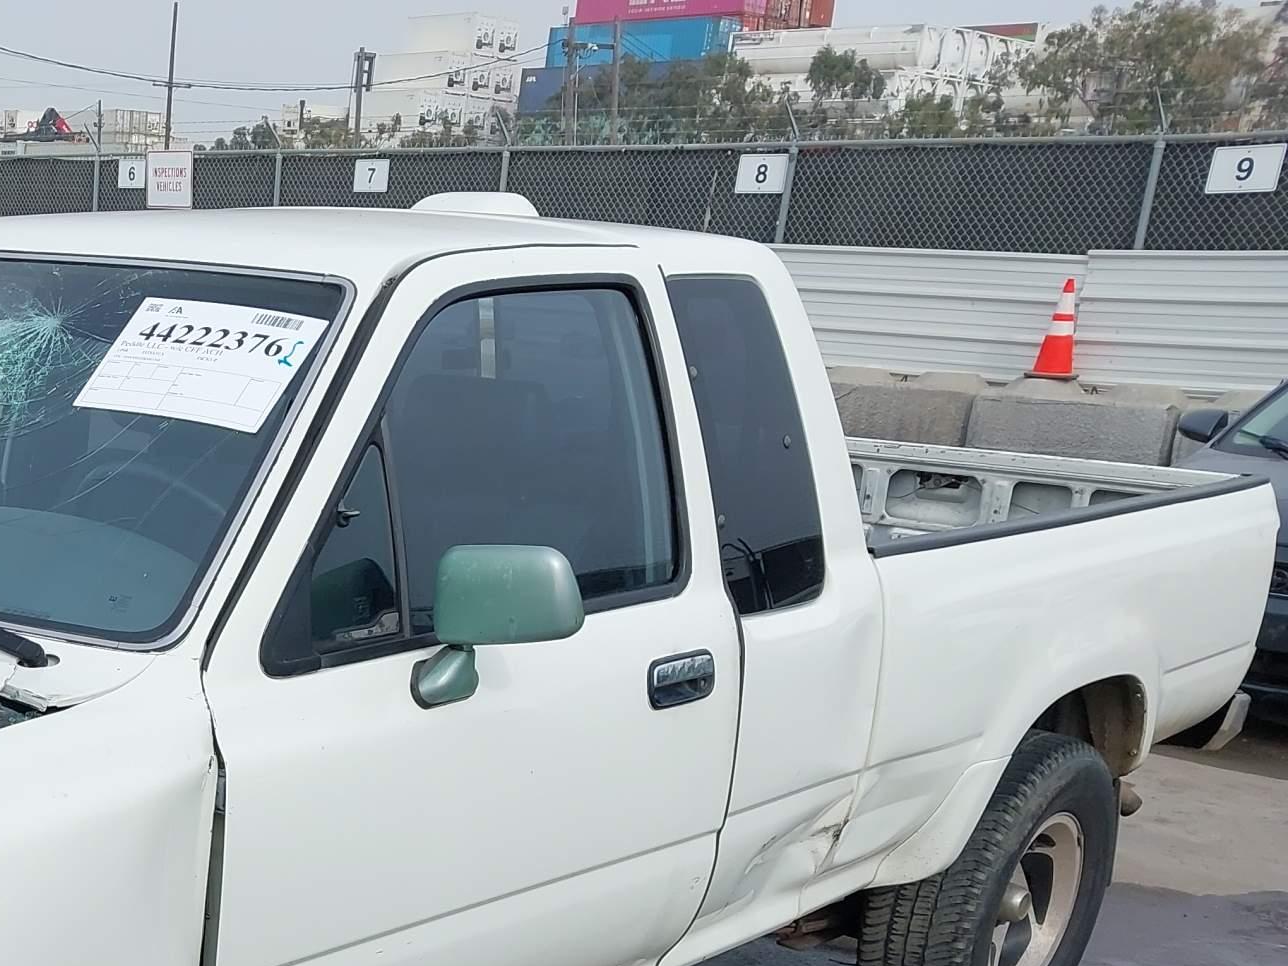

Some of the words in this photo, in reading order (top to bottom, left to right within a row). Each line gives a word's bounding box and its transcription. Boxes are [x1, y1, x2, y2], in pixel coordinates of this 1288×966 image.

[128, 166, 136, 181] 6
[152, 167, 188, 178] INSPECTIONS
[367, 167, 376, 184] 7
[755, 163, 768, 184] 8
[1235, 157, 1255, 181] 9
[156, 181, 183, 192] VEHICLES
[139, 321, 289, 357] 44222376
